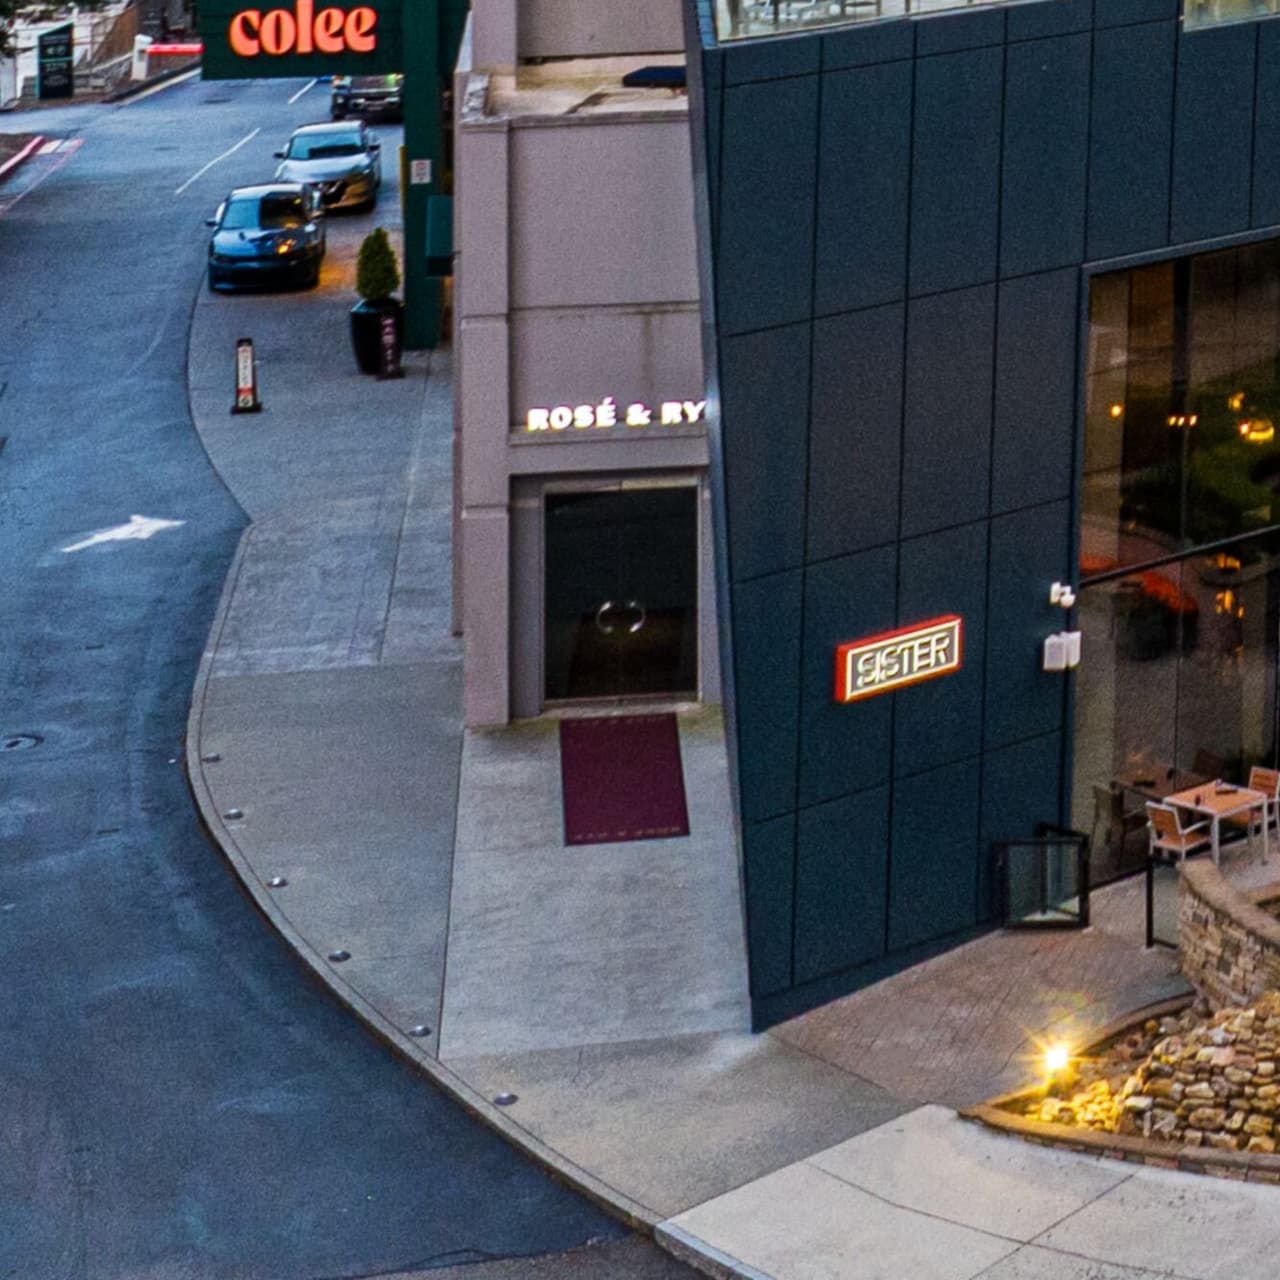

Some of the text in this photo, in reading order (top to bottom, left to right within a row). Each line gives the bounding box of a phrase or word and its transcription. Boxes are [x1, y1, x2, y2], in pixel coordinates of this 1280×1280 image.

[527, 396, 708, 432] ROSÉ & RY
[856, 631, 951, 688] SISTER
